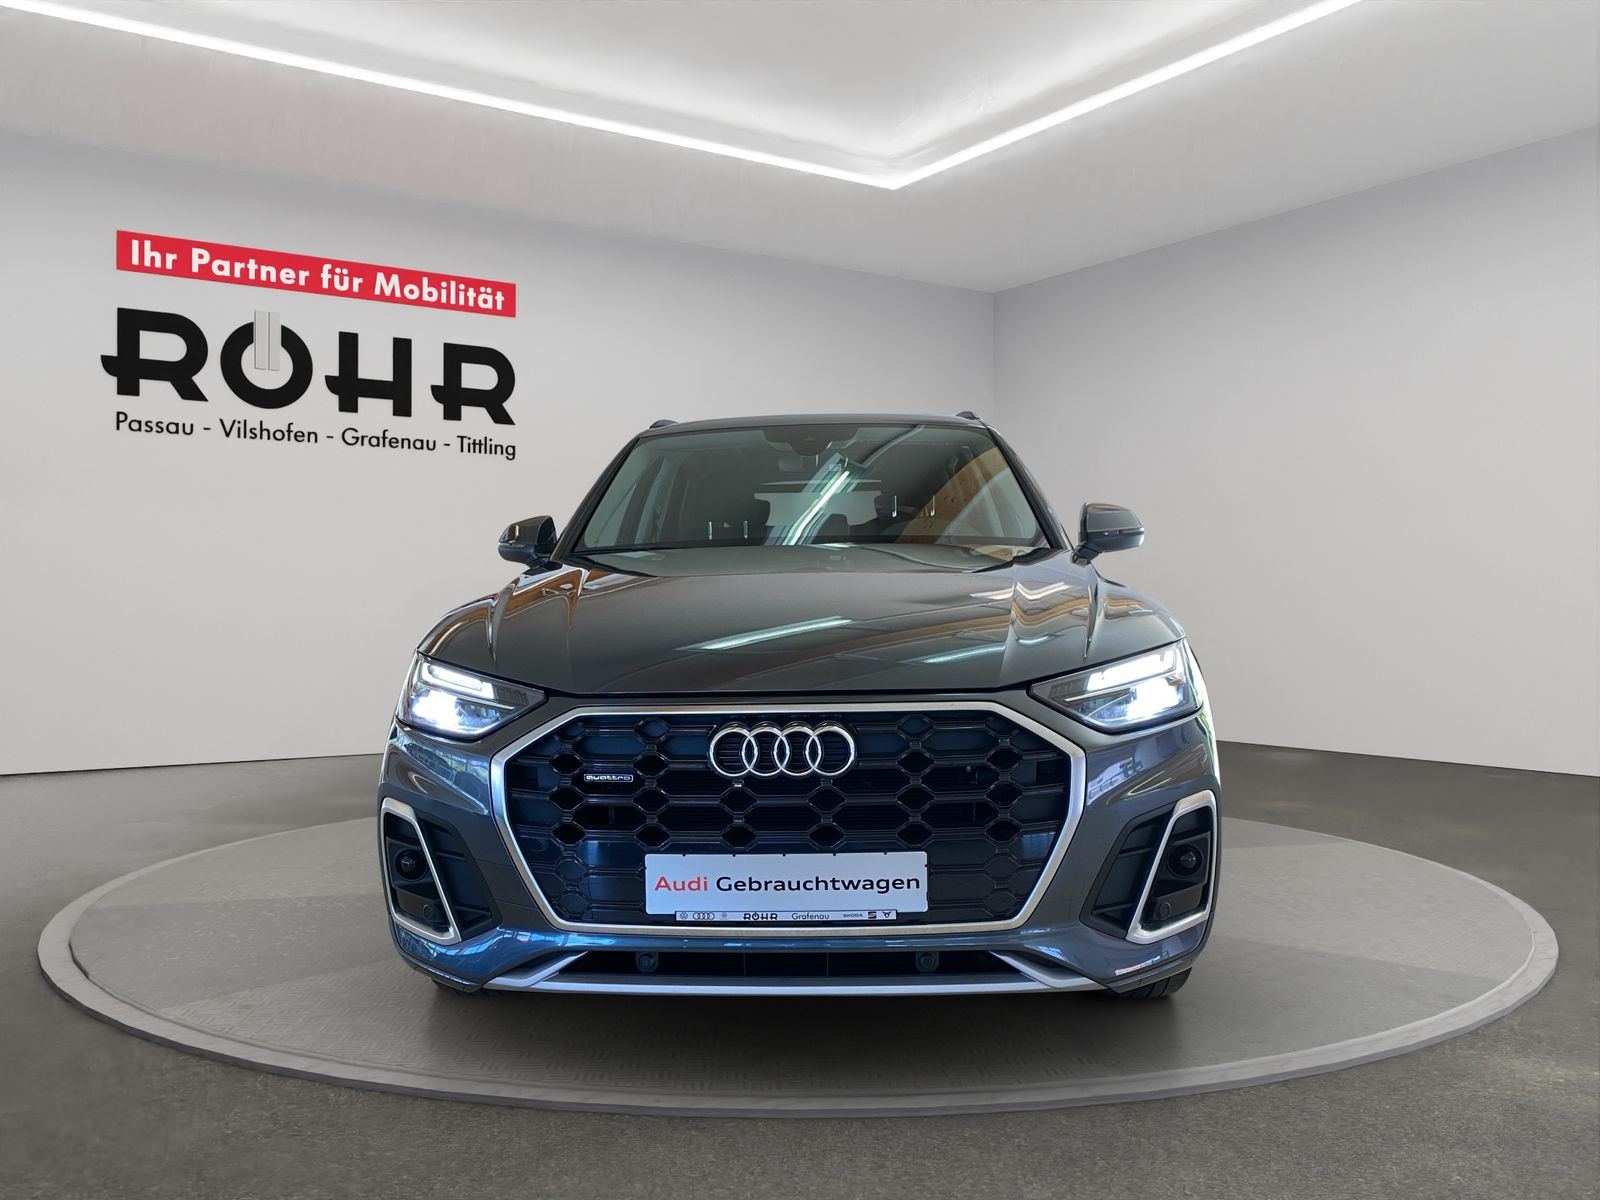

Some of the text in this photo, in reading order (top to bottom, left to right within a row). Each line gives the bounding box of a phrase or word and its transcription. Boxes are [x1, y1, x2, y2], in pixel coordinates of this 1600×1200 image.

[131, 239, 505, 311] Ihr Partner für Mobilität
[101, 307, 517, 426] RÖHR
[115, 411, 194, 436] Passau
[219, 418, 318, 444] Vilshofen
[341, 427, 437, 452] Grafenau
[457, 435, 517, 461] Tittling
[654, 875, 921, 894] Audi Gebrauchtwagen
[791, 912, 830, 920] Grafenau
